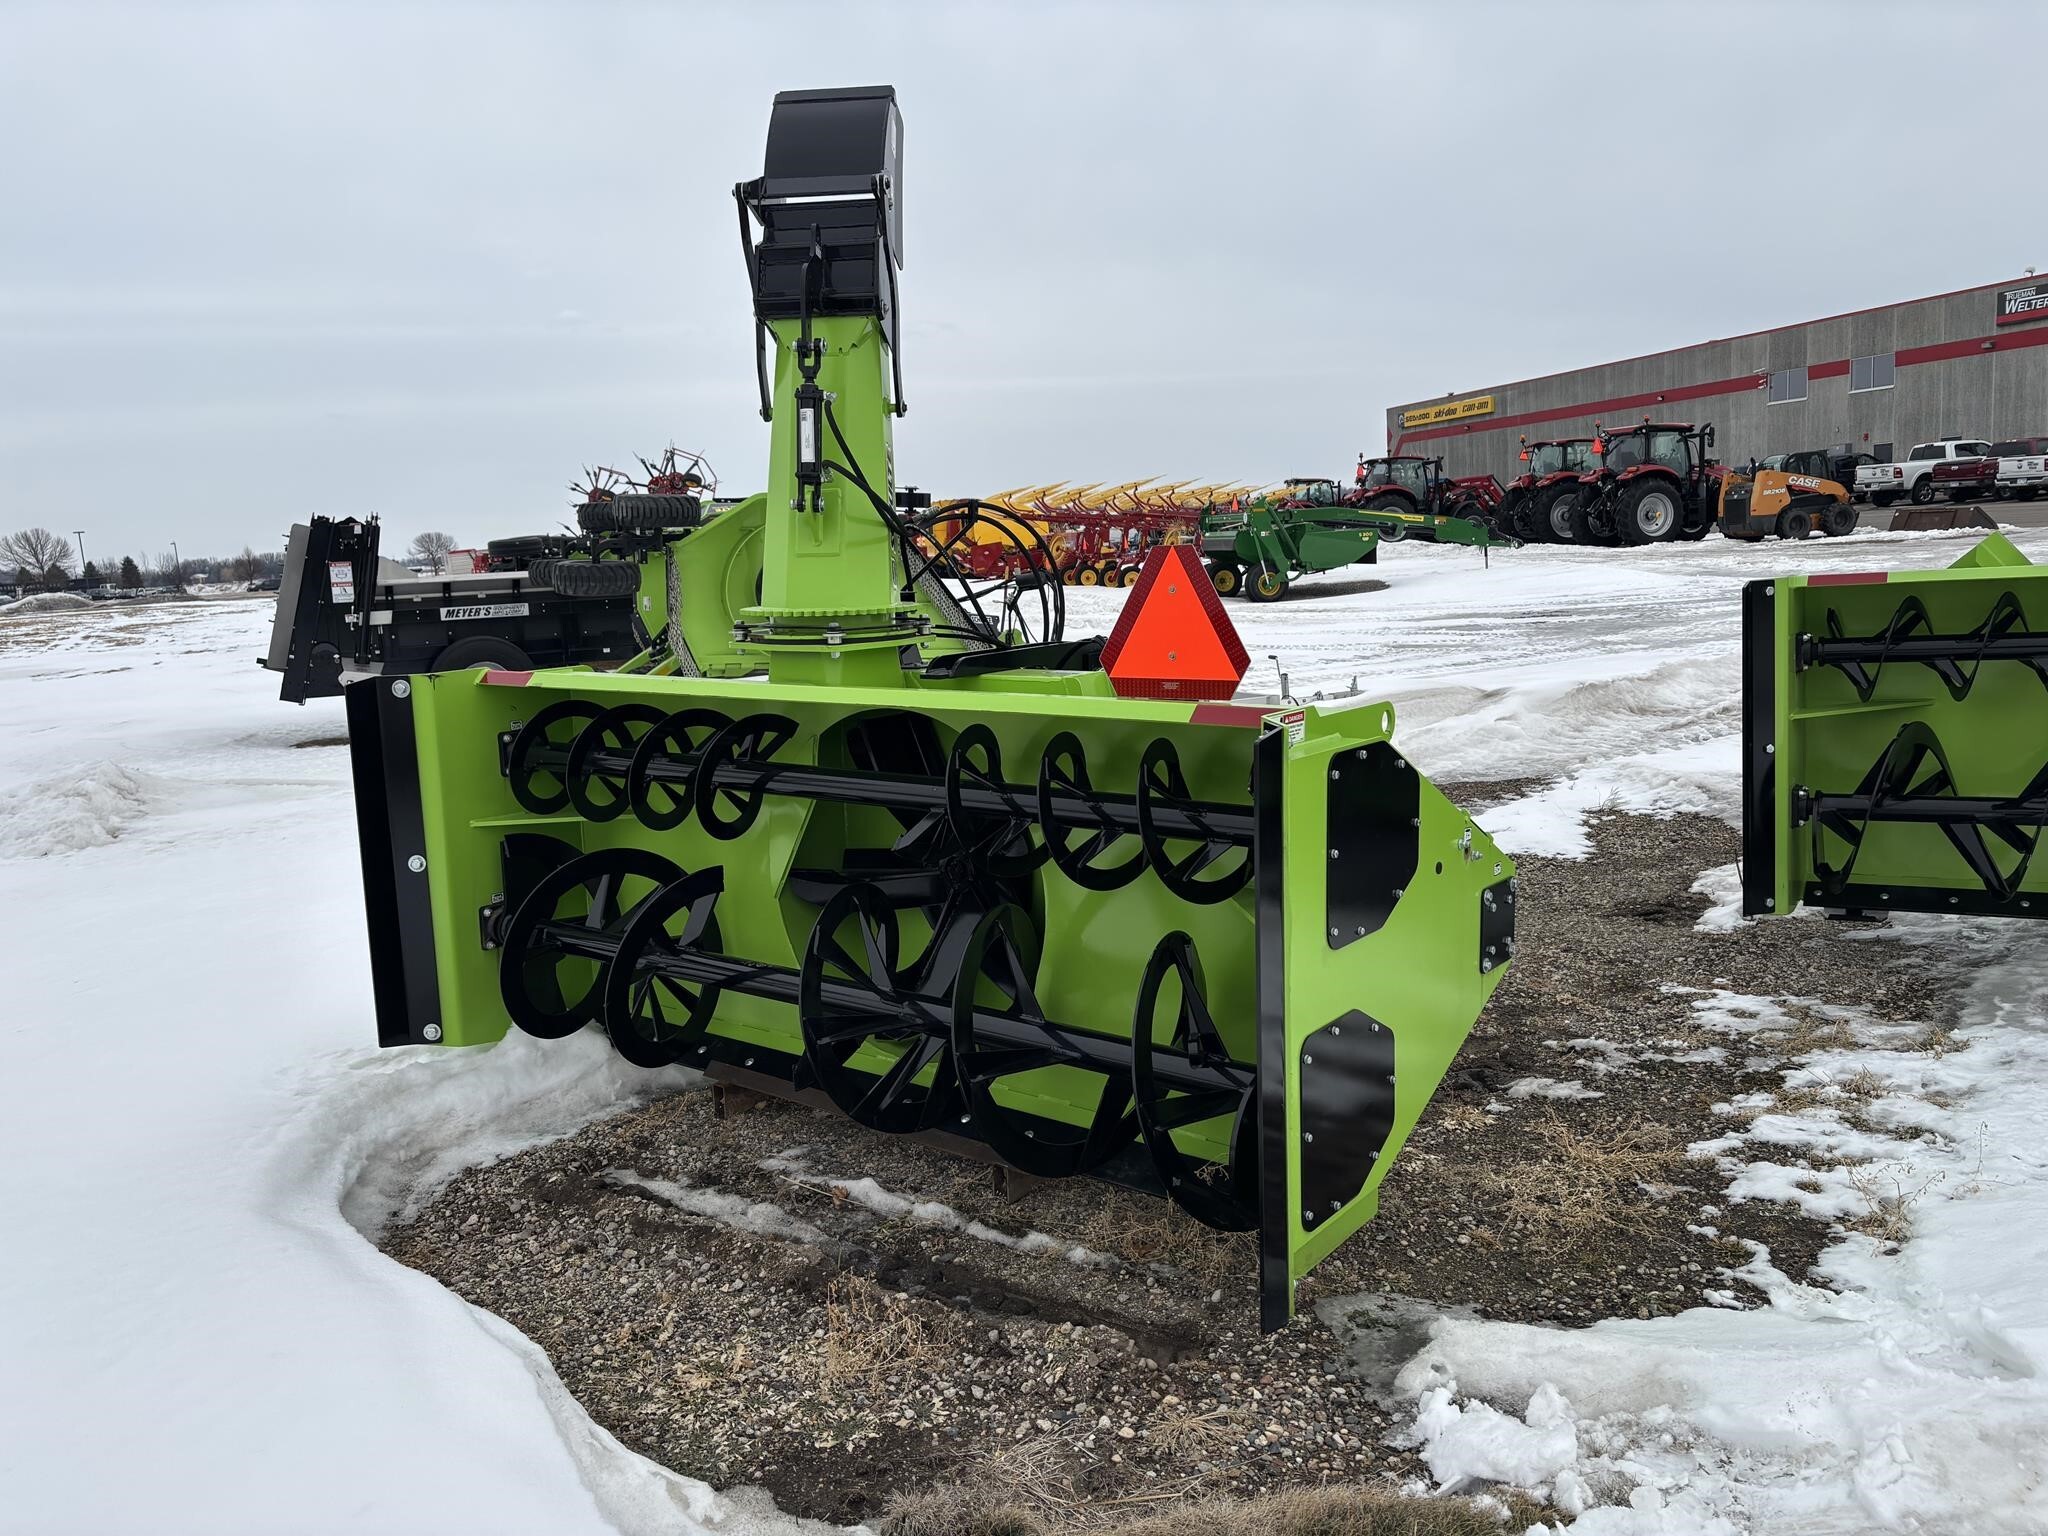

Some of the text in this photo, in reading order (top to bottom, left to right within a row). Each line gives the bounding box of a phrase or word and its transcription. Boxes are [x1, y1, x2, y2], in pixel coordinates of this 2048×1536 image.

[2004, 287, 2036, 301] TRUEMAN
[1788, 475, 1821, 488] CASE
[444, 606, 492, 619] MEYER'S
